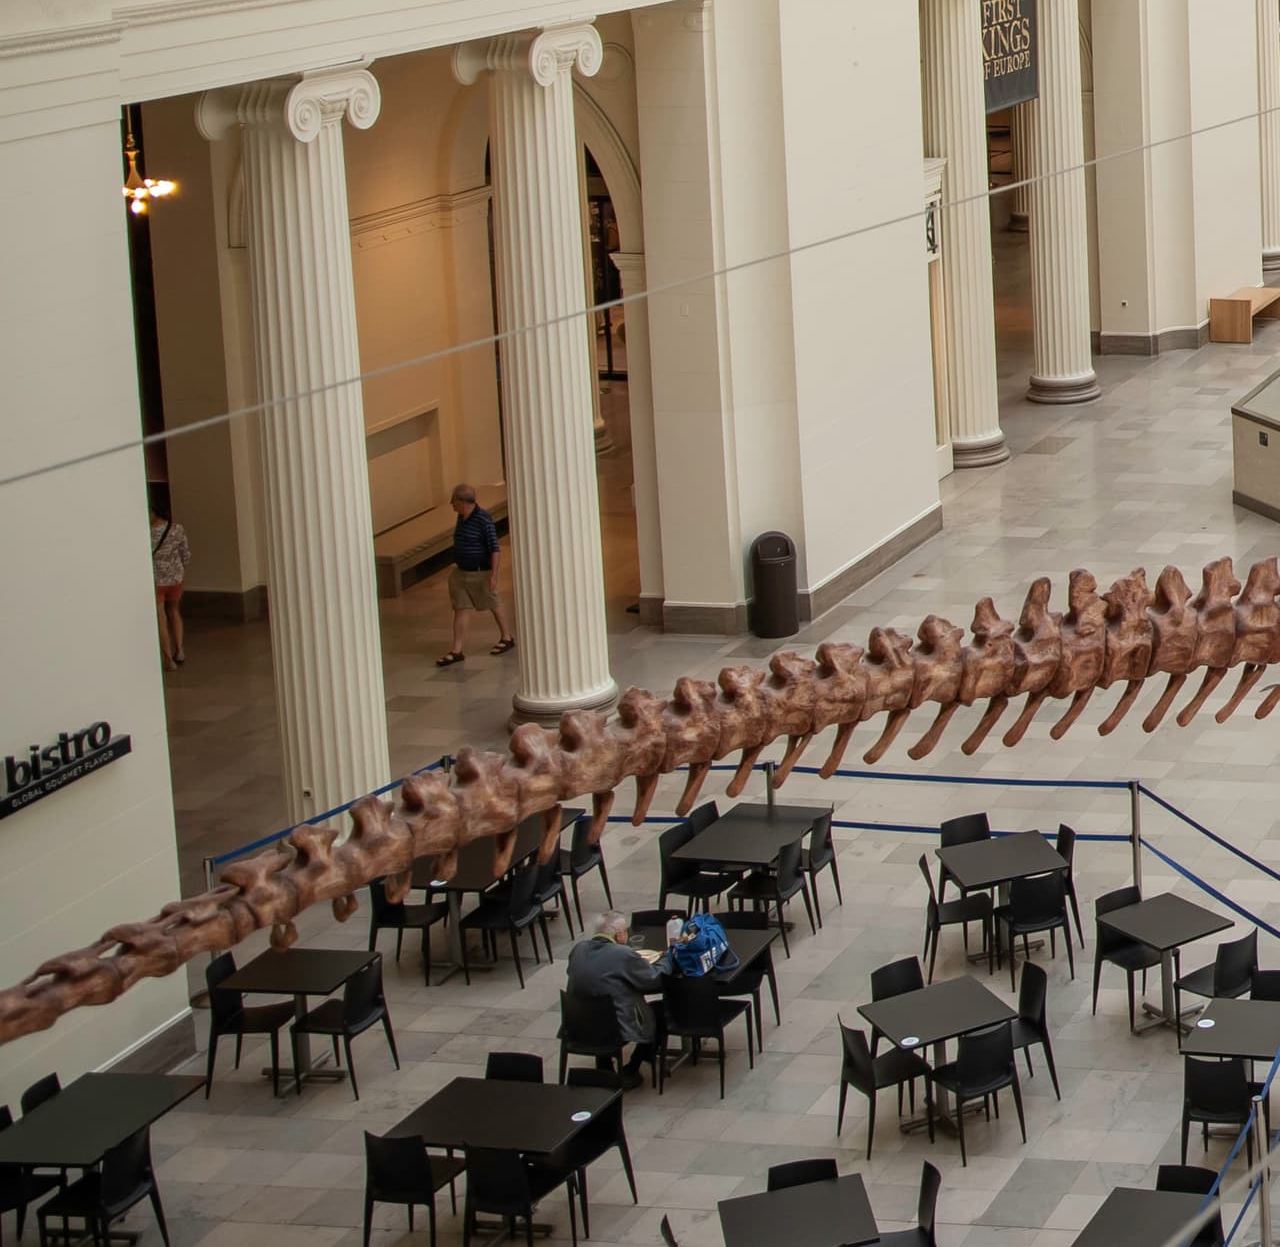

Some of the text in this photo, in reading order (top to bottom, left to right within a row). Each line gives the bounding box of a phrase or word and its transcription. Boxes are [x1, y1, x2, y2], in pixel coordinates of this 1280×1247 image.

[993, 50, 1031, 78] EUROPE
[5, 721, 112, 794] bistro
[11, 749, 114, 808] GLOBAL GOURMET FLAVOR
